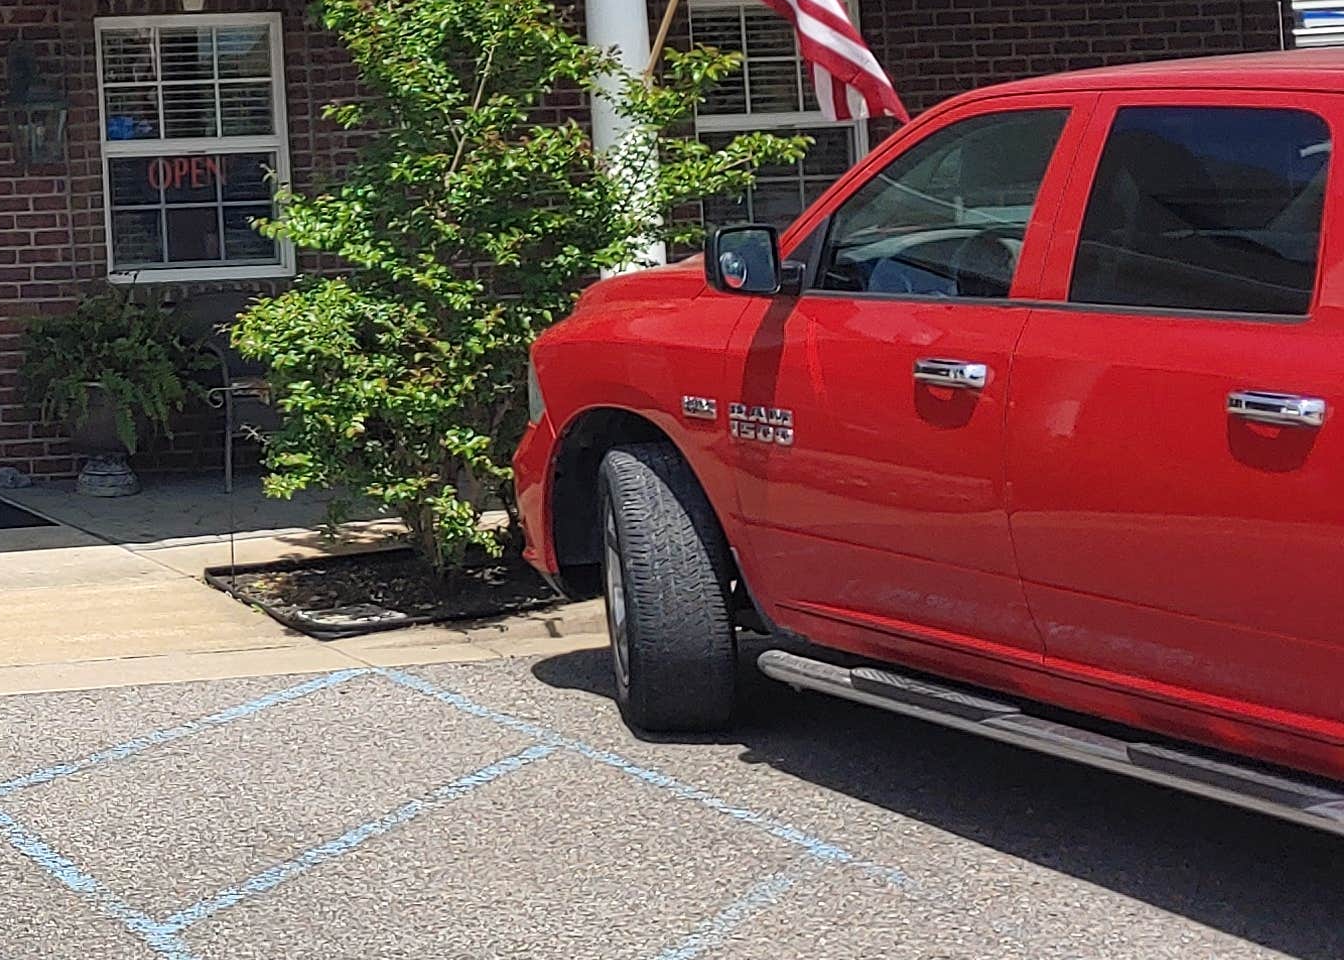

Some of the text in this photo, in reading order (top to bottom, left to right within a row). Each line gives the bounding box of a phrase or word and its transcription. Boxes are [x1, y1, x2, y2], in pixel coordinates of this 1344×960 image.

[148, 156, 226, 189] OPEN
[729, 402, 793, 427] RAM
[730, 420, 794, 446] 1500
